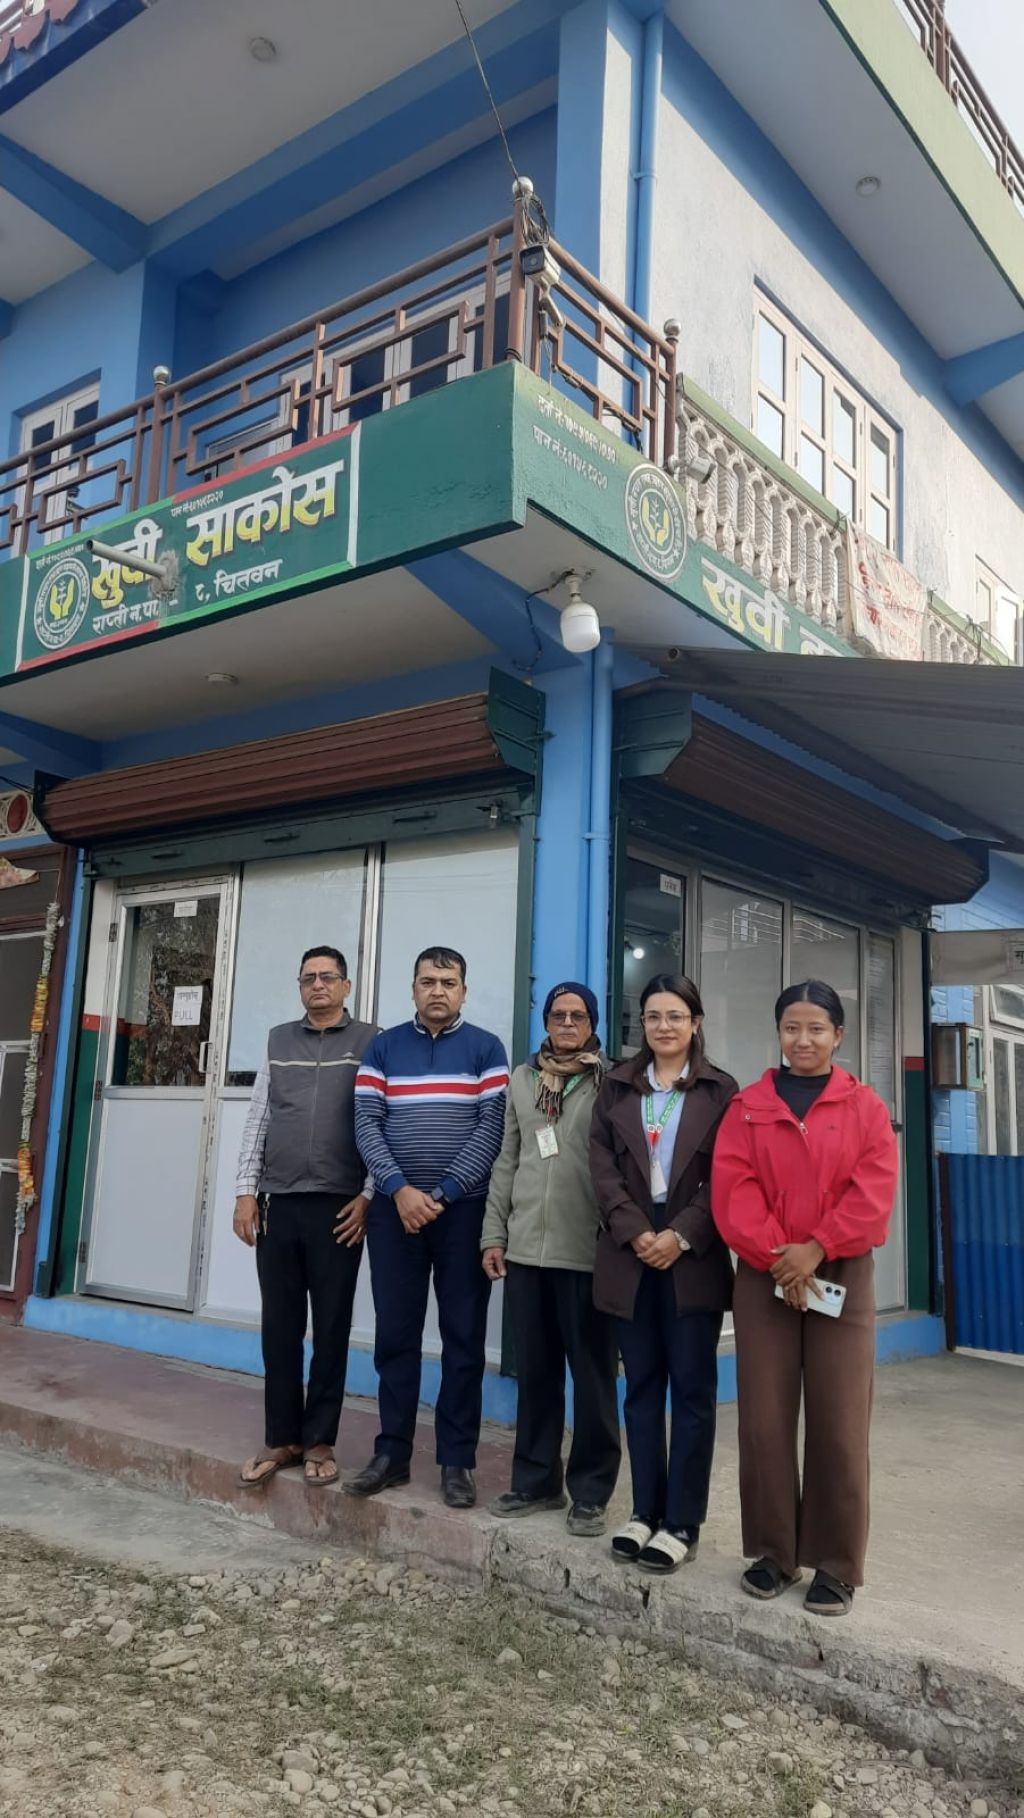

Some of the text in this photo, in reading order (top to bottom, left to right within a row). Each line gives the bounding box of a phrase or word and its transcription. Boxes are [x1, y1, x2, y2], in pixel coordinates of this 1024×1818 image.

[185, 459, 345, 567] साकोस
[92, 603, 129, 634] राप्ती
[213, 558, 283, 597] चितवन
